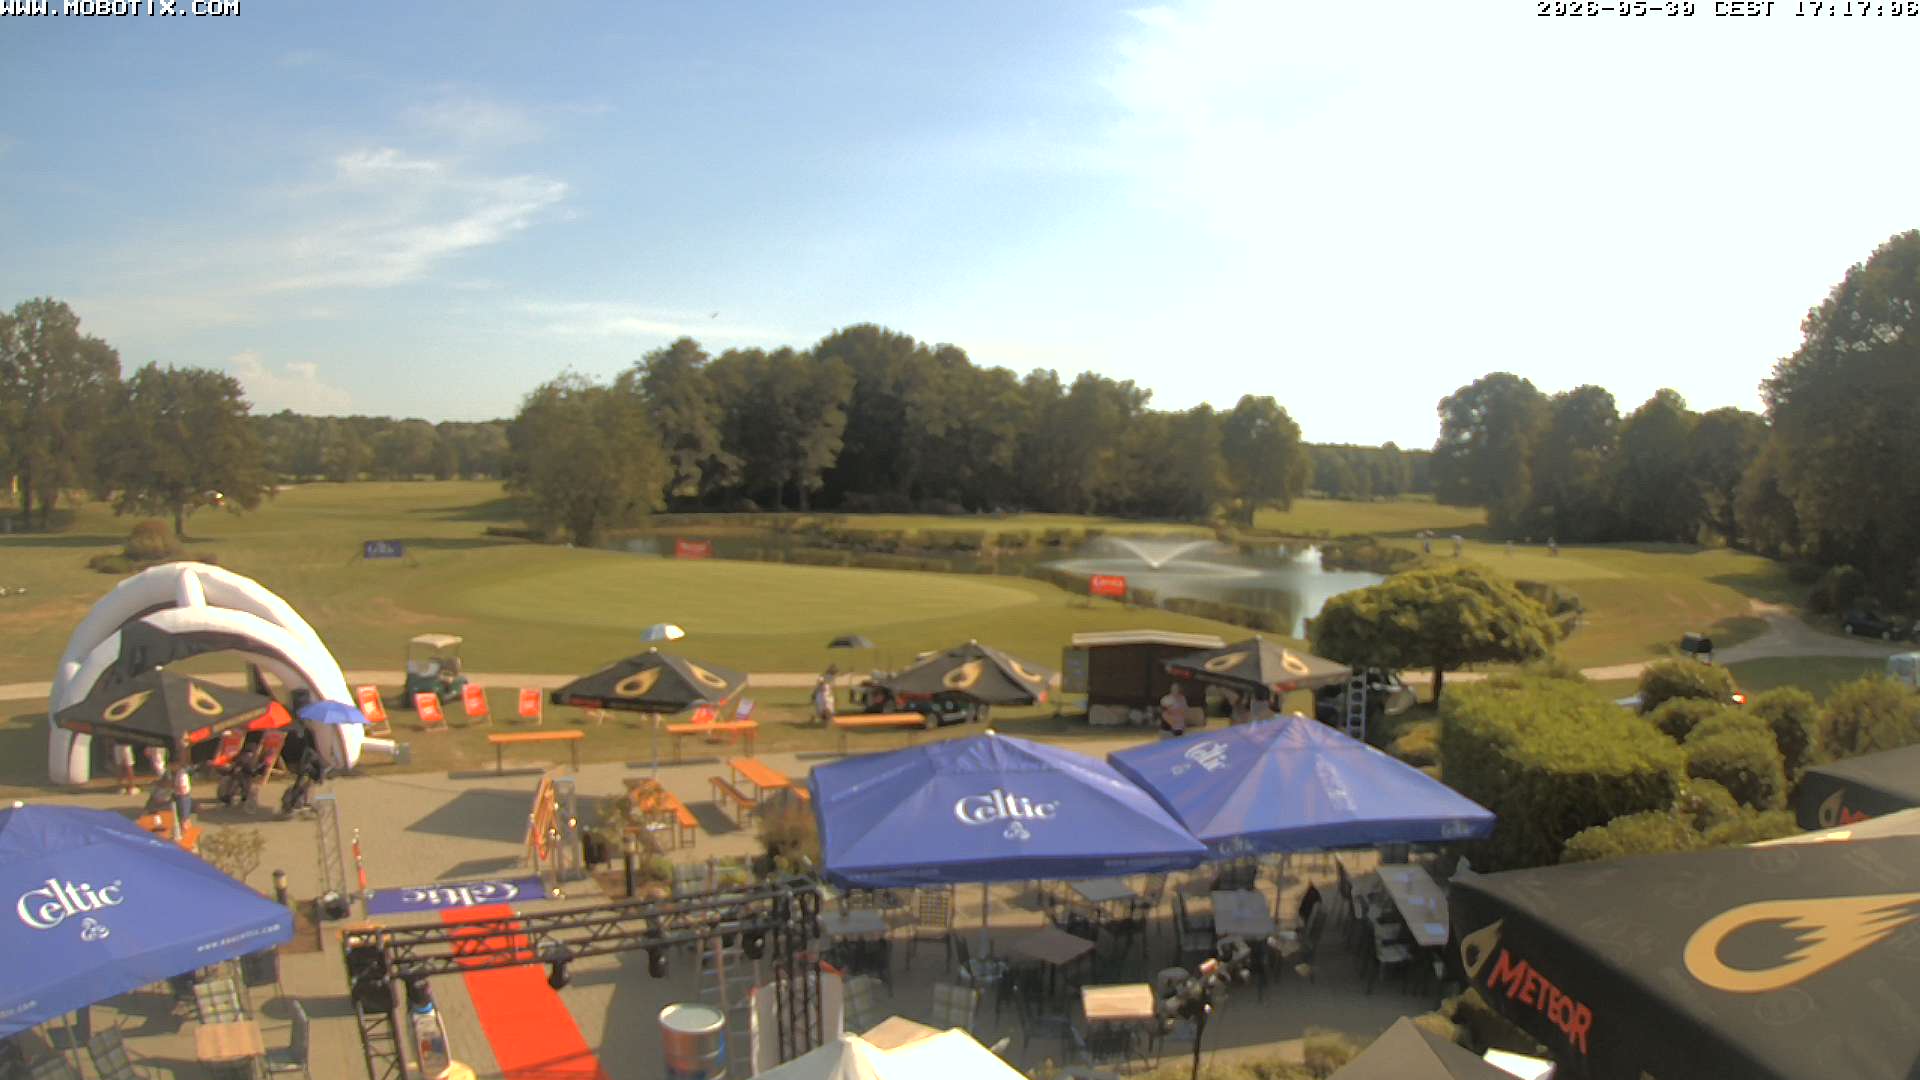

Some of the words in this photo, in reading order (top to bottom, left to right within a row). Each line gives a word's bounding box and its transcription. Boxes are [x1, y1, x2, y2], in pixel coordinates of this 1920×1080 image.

[954, 788, 1056, 824] Celtic
[17, 878, 124, 930] Celtic
[1487, 948, 1592, 1056] METEOR
